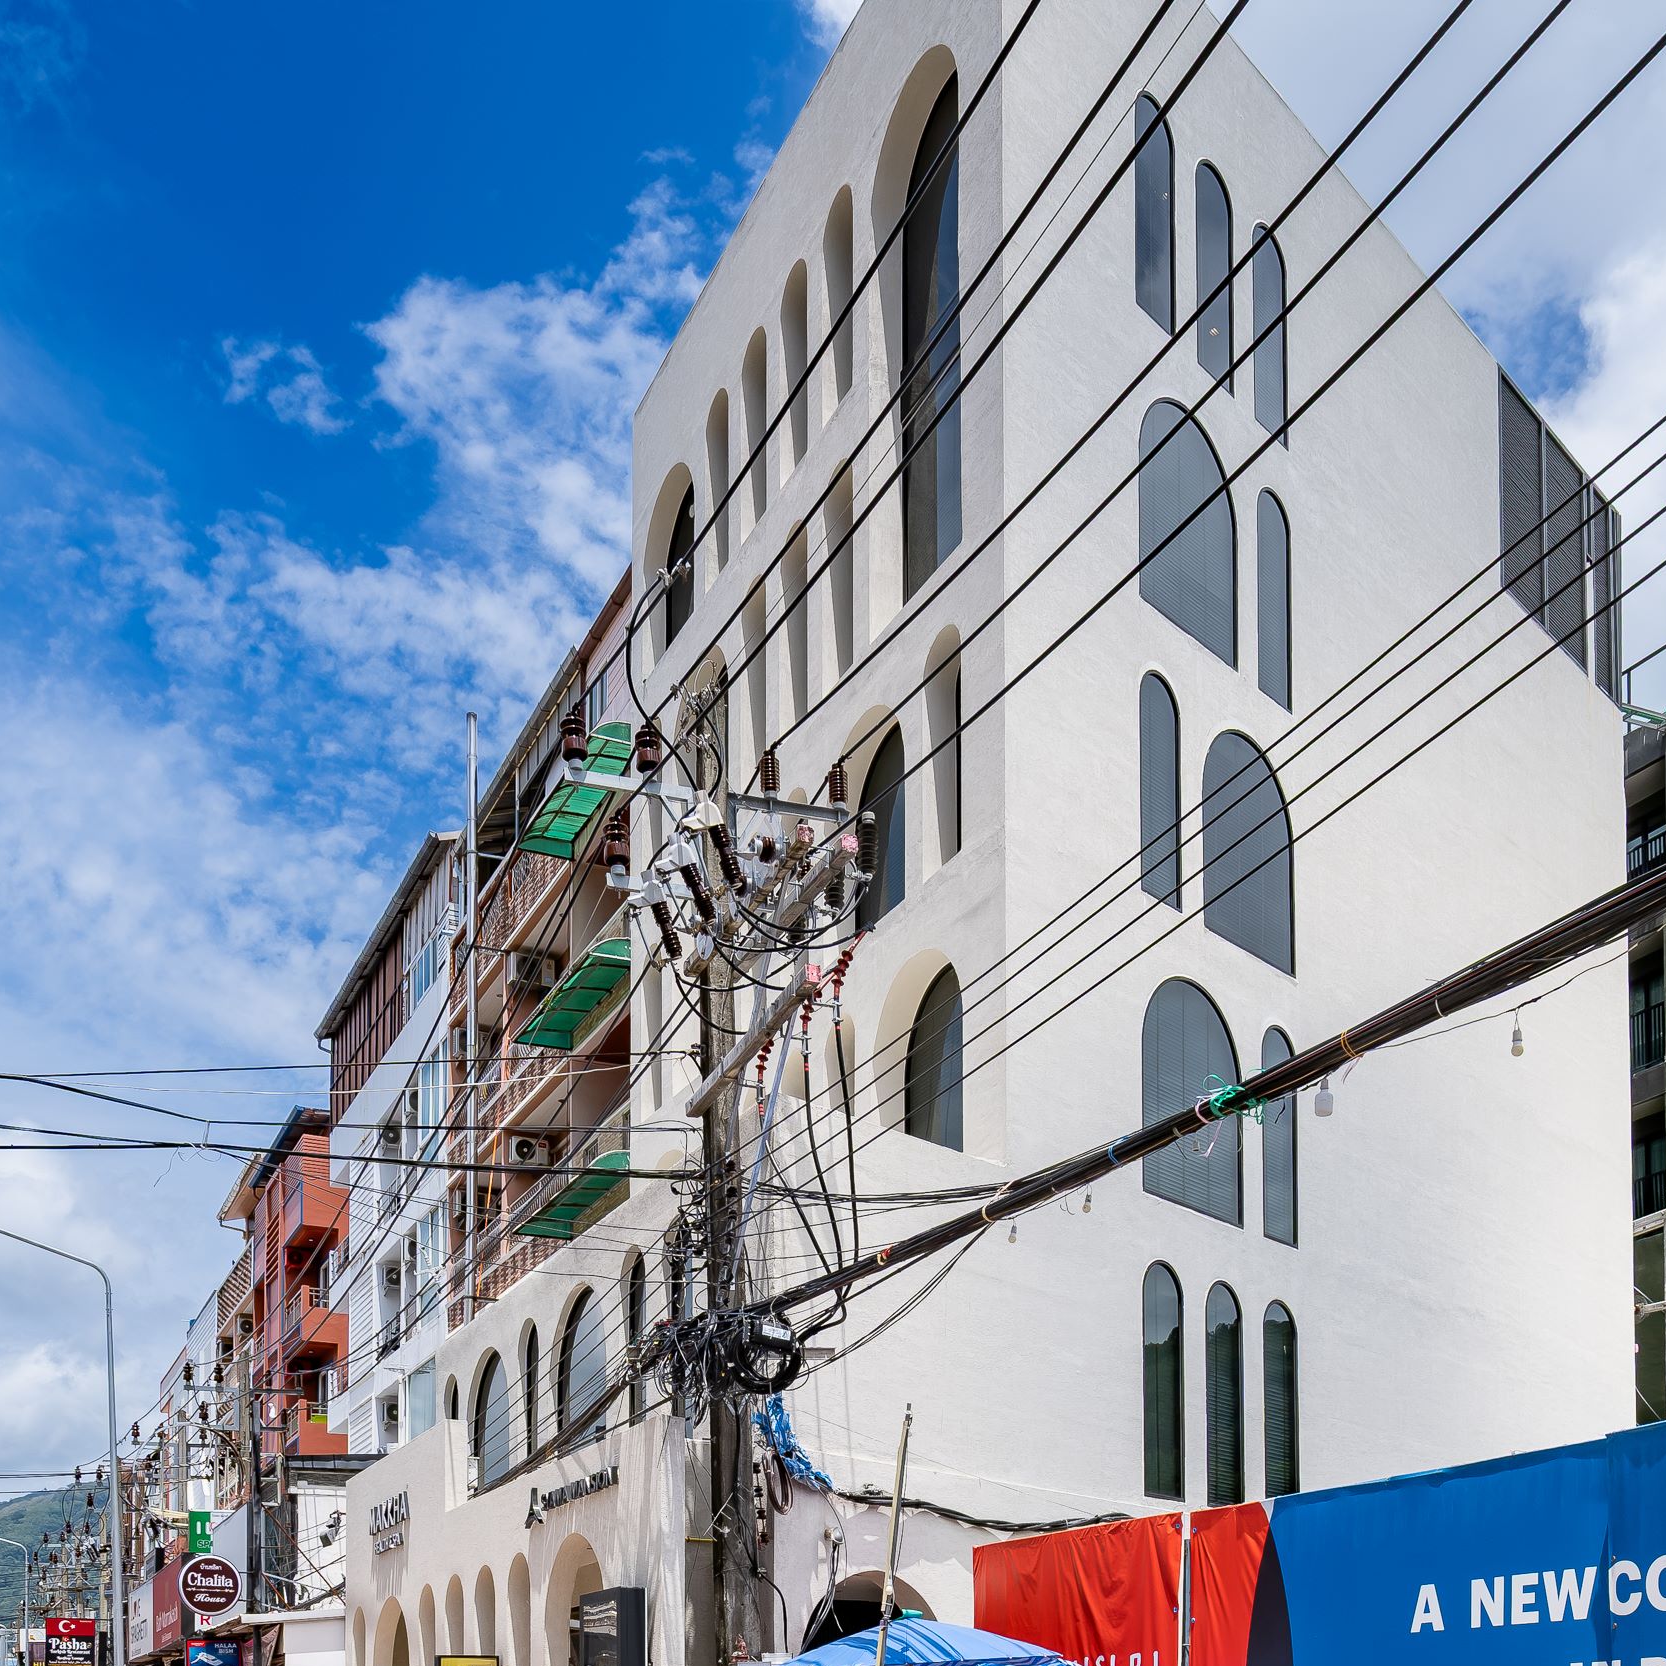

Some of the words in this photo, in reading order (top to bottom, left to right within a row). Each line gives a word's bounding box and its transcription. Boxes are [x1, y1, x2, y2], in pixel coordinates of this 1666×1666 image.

[187, 1572, 233, 1588] Chalita
[193, 1593, 227, 1603] House
[1410, 1583, 1445, 1633] A
[1470, 1566, 1598, 1629] NEW
[48, 1637, 87, 1650] Pasha
